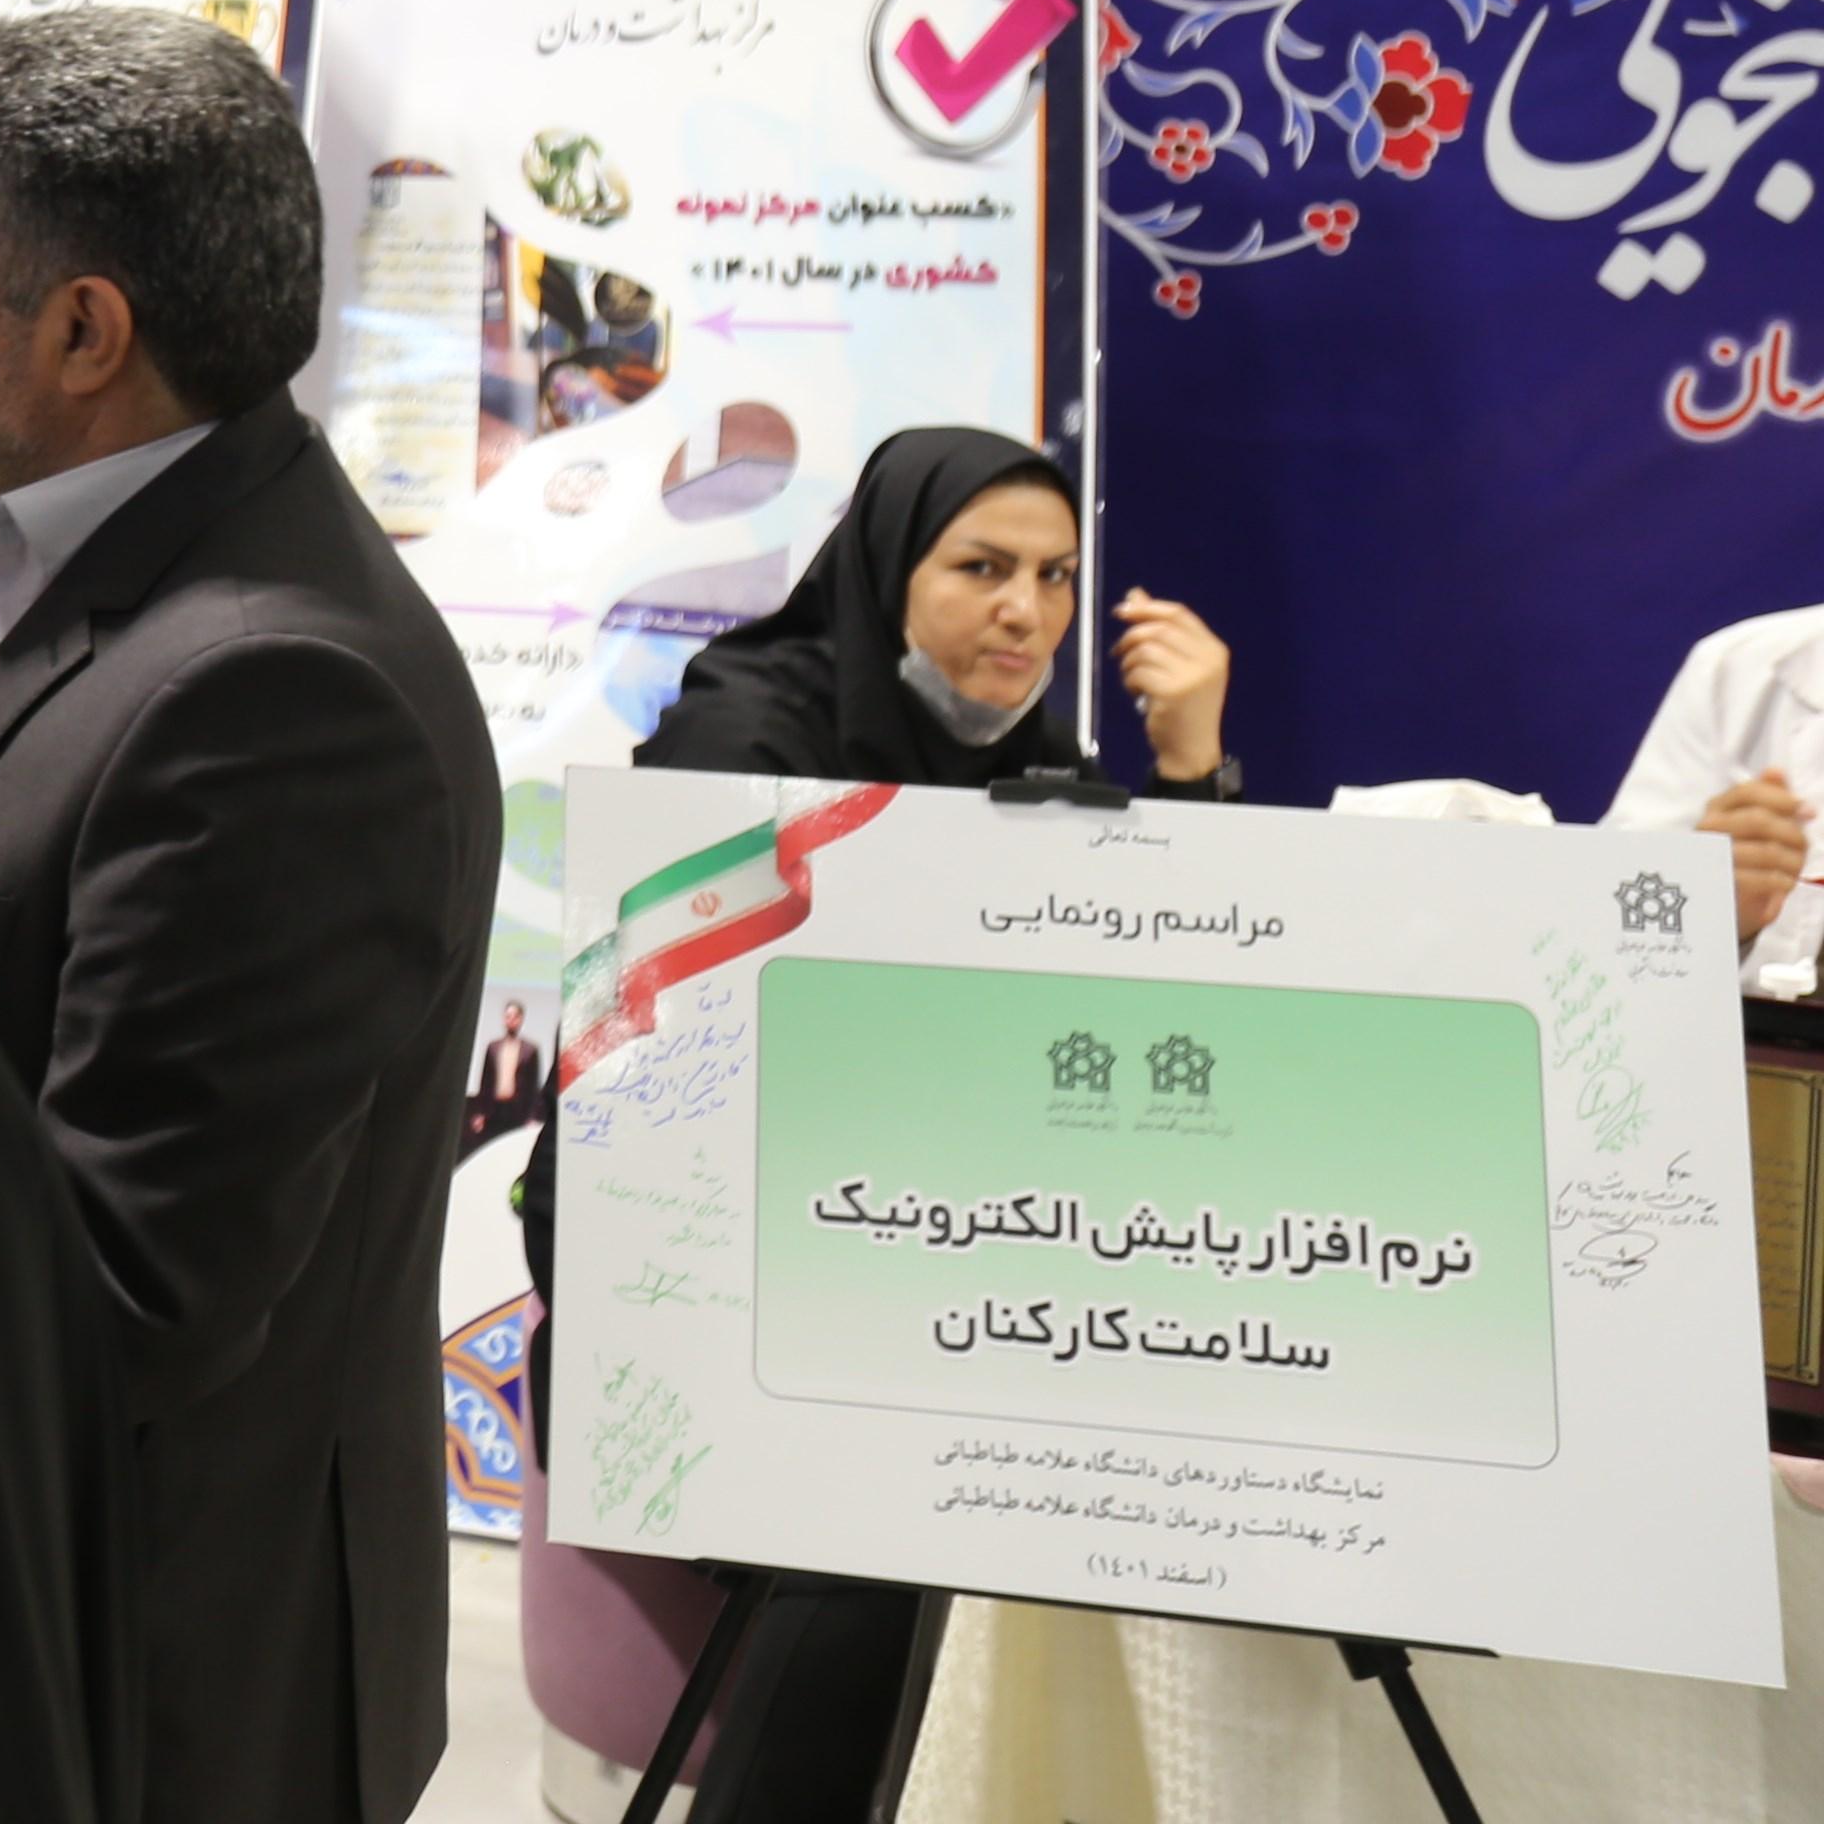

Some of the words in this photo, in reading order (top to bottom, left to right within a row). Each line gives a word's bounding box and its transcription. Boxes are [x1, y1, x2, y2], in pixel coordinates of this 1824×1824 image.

[536, 6, 602, 56] درمان
[980, 893, 1143, 940] رونمایی
[1153, 903, 1286, 947] مراسم
[813, 1181, 1078, 1246] الکترونیک
[1090, 1206, 1242, 1277] پایش
[1248, 1216, 1369, 1277] افزار
[1377, 1229, 1474, 1286] نرم
[932, 1298, 1131, 1361] کارکنان
[1138, 1318, 1331, 1371] سلامت
[1023, 1449, 1077, 1472] علامه
[1083, 1449, 1158, 1479] دانشگاه
[1162, 1461, 1289, 1491] دستاوردهای
[1292, 1469, 1384, 1504] نمایشگاه
[1023, 1494, 1078, 1518] علامه
[1083, 1495, 1157, 1526] دانشگاه
[1163, 1511, 1222, 1537] درمان
[1227, 1522, 1238, 1539] و
[1241, 1516, 1327, 1550] بهداشت
[1334, 1522, 1387, 1554] مرکز
